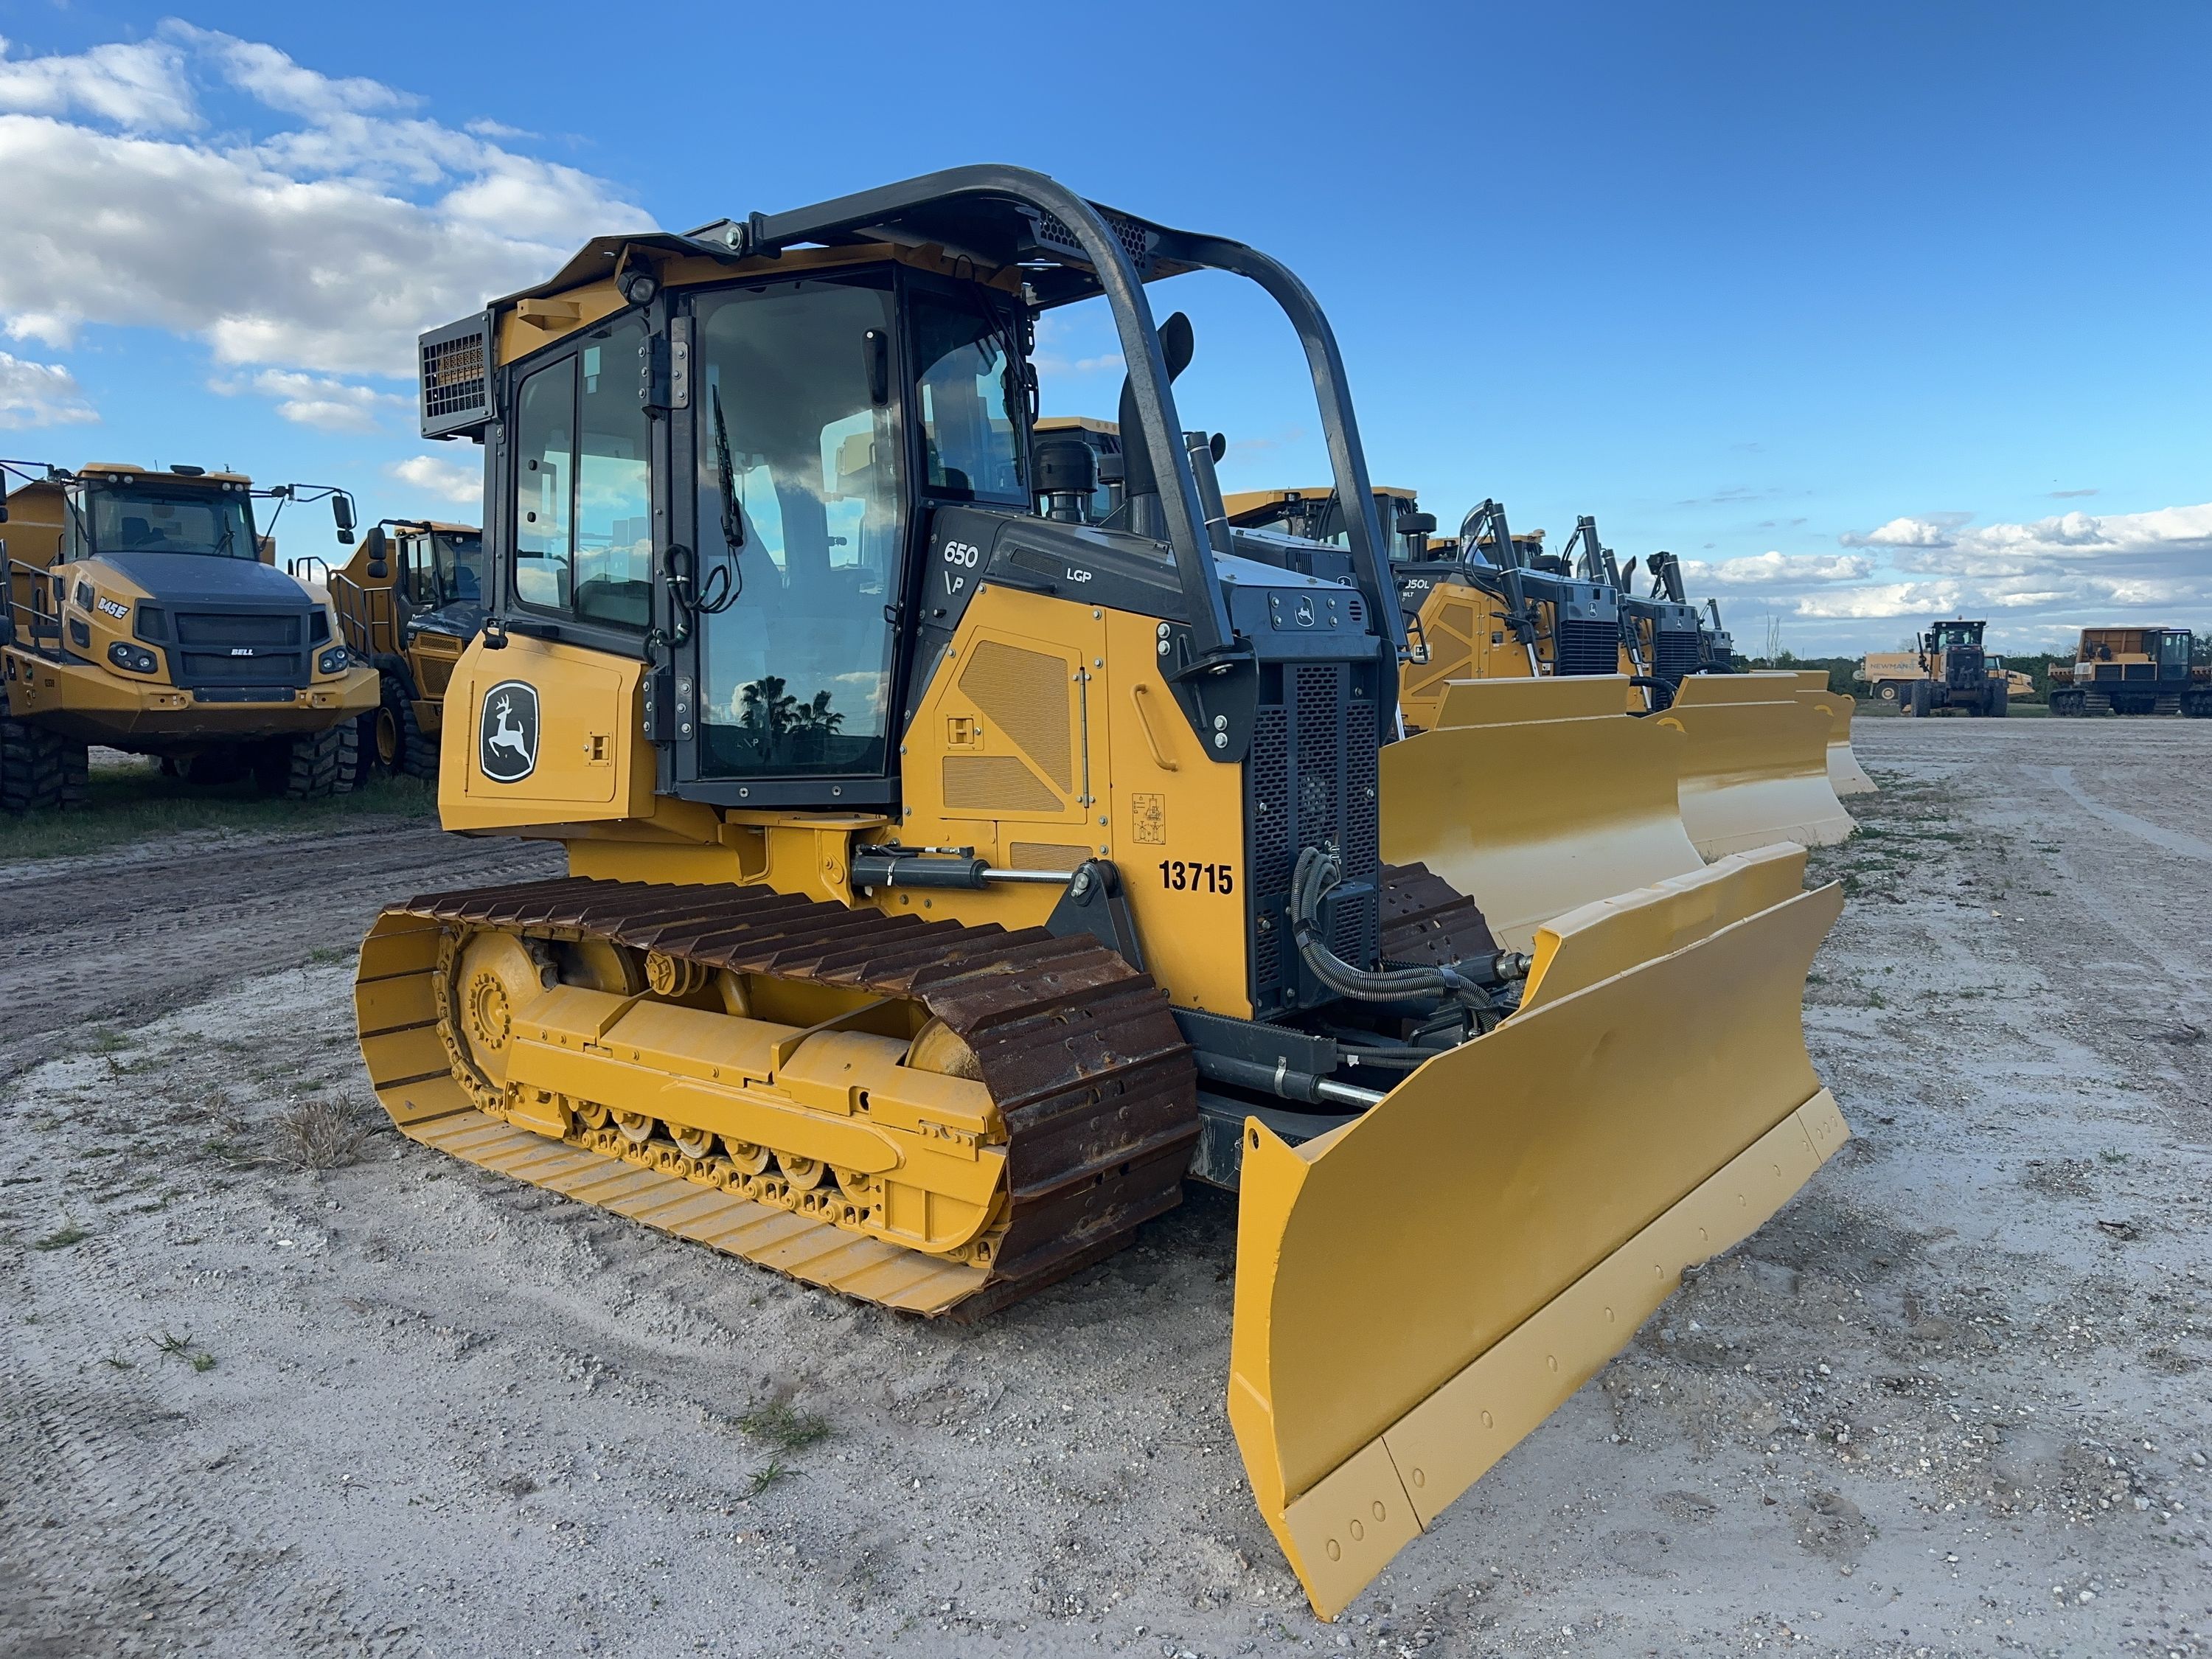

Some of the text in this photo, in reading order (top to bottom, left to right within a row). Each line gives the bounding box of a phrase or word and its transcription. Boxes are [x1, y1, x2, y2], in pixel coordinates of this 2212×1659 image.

[944, 540, 978, 568] 650
[1066, 567, 1092, 583] LGP
[97, 597, 130, 619] B45E
[1158, 860, 1233, 895] 13715
